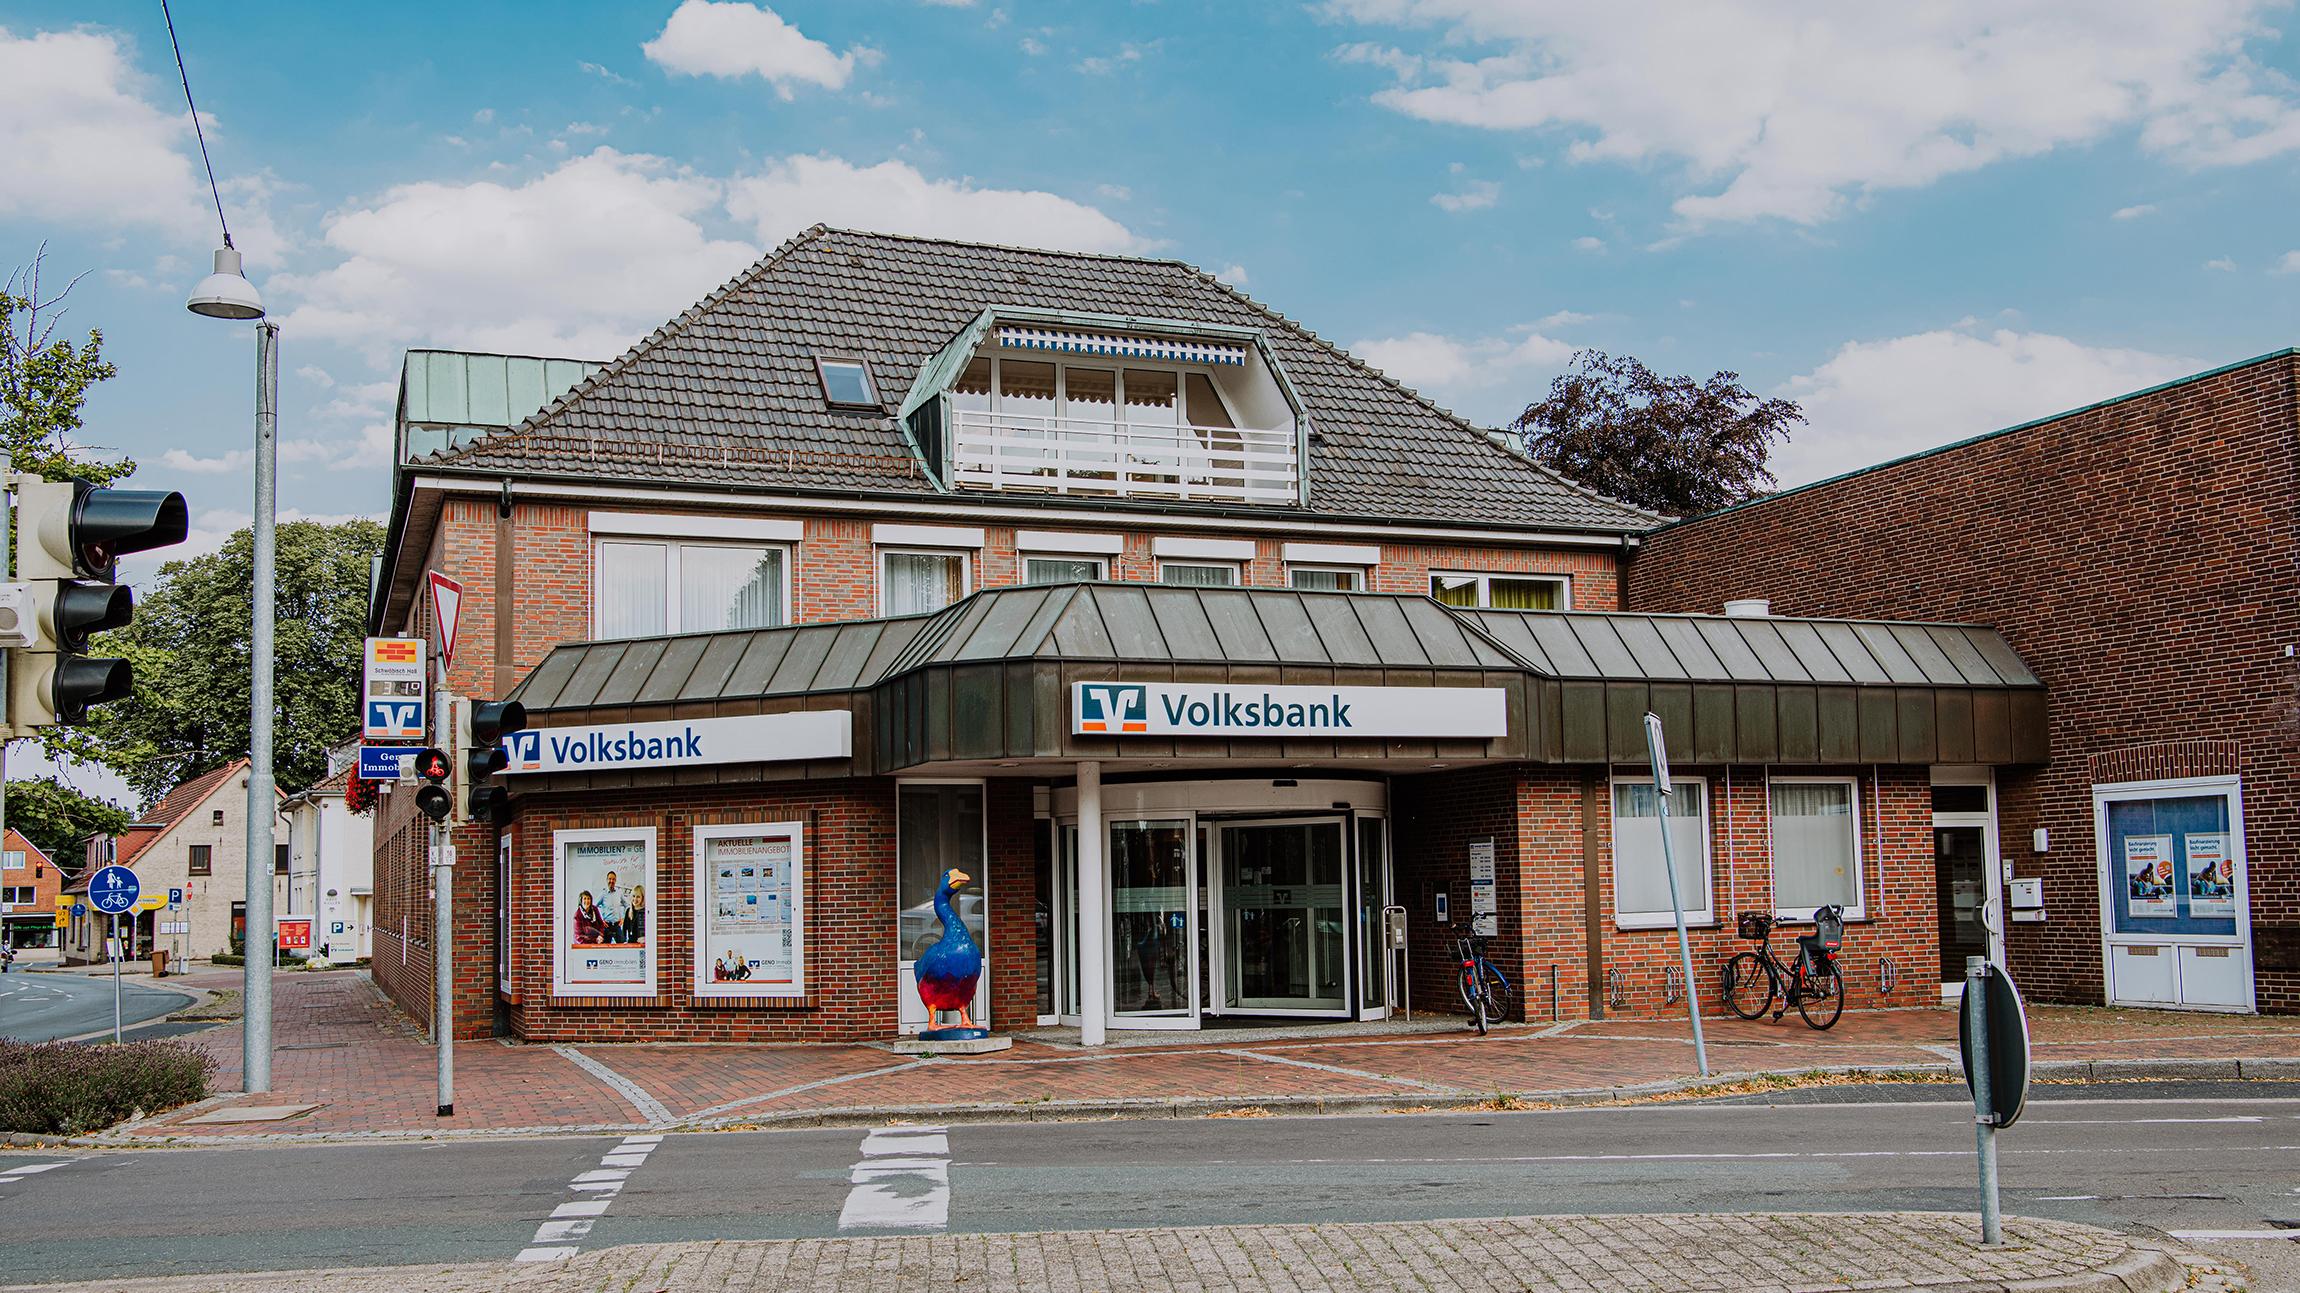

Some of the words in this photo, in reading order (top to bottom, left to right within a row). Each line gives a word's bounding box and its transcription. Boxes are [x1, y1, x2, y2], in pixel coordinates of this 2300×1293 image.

[1160, 692, 1353, 728] Volksbank
[551, 727, 702, 764] Volksbank
[717, 837, 753, 847] AKTUELLE
[577, 845, 626, 854] IMMOBILIEN?
[717, 845, 791, 856] IMMOBILIENANGEBOT
[333, 923, 342, 933] P
